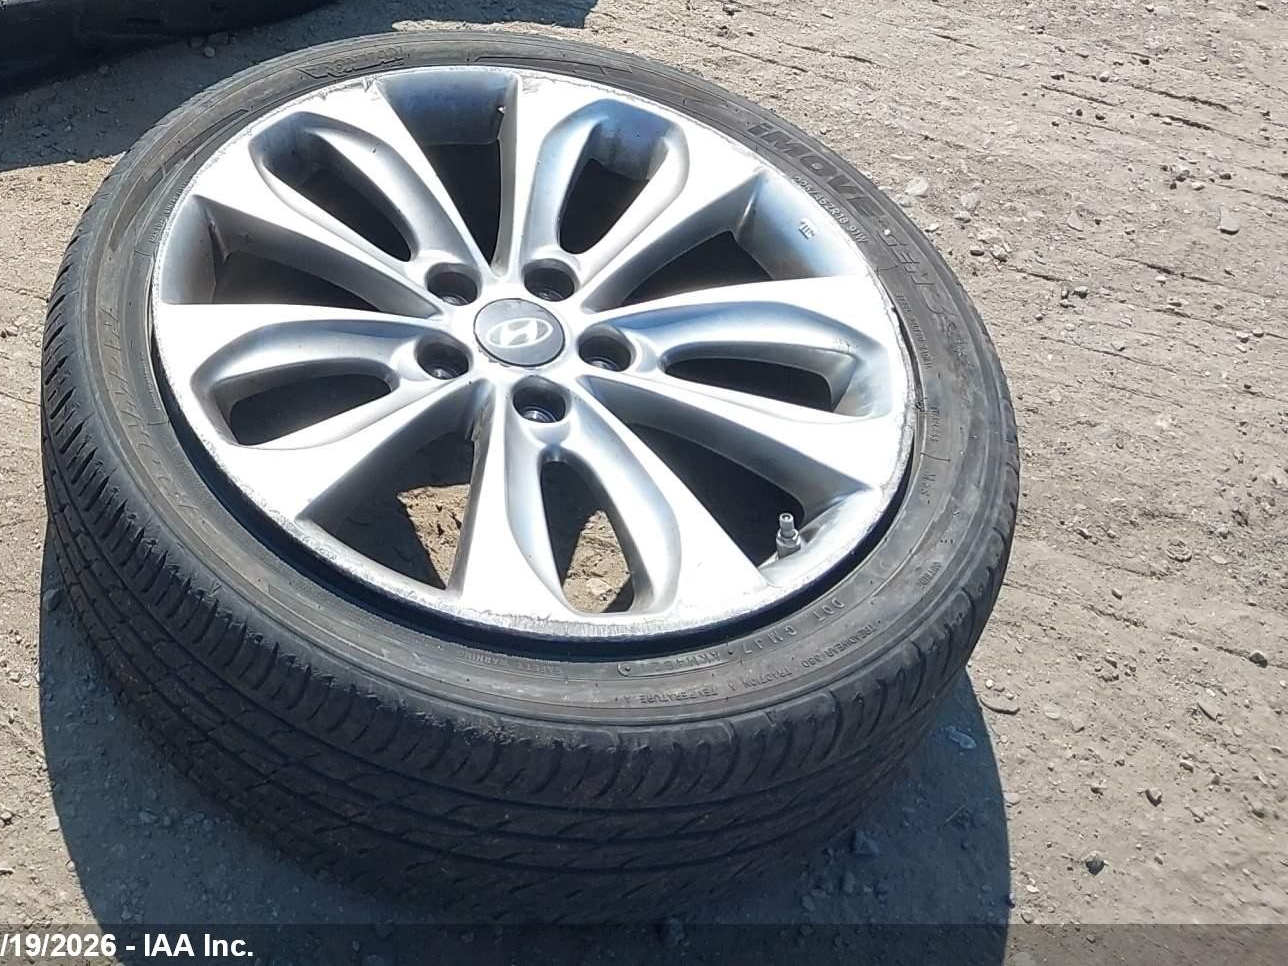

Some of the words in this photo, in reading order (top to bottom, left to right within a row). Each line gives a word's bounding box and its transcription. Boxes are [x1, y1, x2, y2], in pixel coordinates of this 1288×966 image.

[845, 224, 869, 243] 91W
[812, 597, 845, 622] DOT
[824, 623, 876, 659] TREADWEAR
[742, 666, 792, 690] TRACTION
[639, 686, 718, 706] TEMPERATURE
